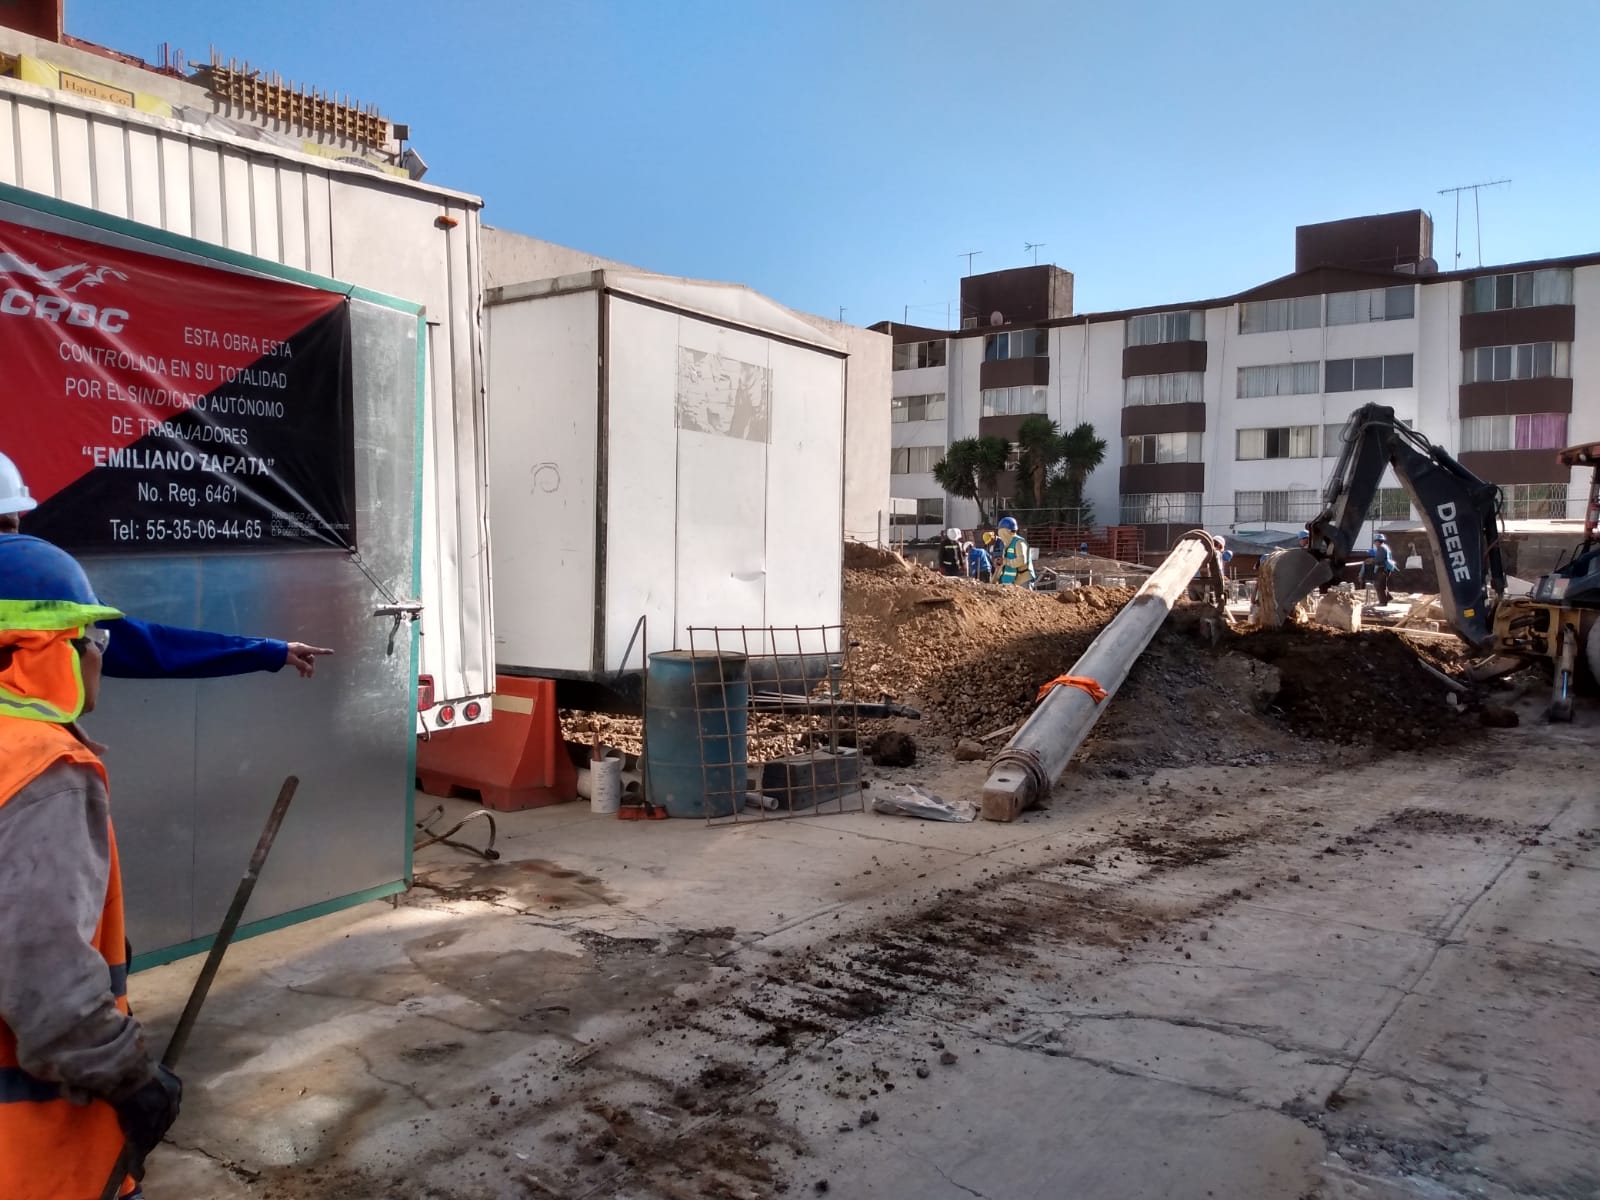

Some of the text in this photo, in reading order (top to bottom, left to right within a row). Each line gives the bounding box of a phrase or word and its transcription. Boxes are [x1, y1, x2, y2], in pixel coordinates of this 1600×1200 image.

[1, 287, 129, 333] CROC
[184, 326, 292, 358] ESTA OBRA ESTA
[60, 342, 287, 389] CONTROLADA EN SU TOTALIDAD
[65, 377, 284, 418] POR EL SINDICATO AUTÓNOMO
[111, 416, 248, 445] DE TRABAJADORES
[82, 446, 275, 476] “EMILIANO ZAPATA”
[138, 482, 237, 507] No. Reg. 6461
[109, 519, 139, 541] Tel:
[146, 519, 262, 540] 55-35-06-44-65
[1437, 501, 1471, 583] DEERE
